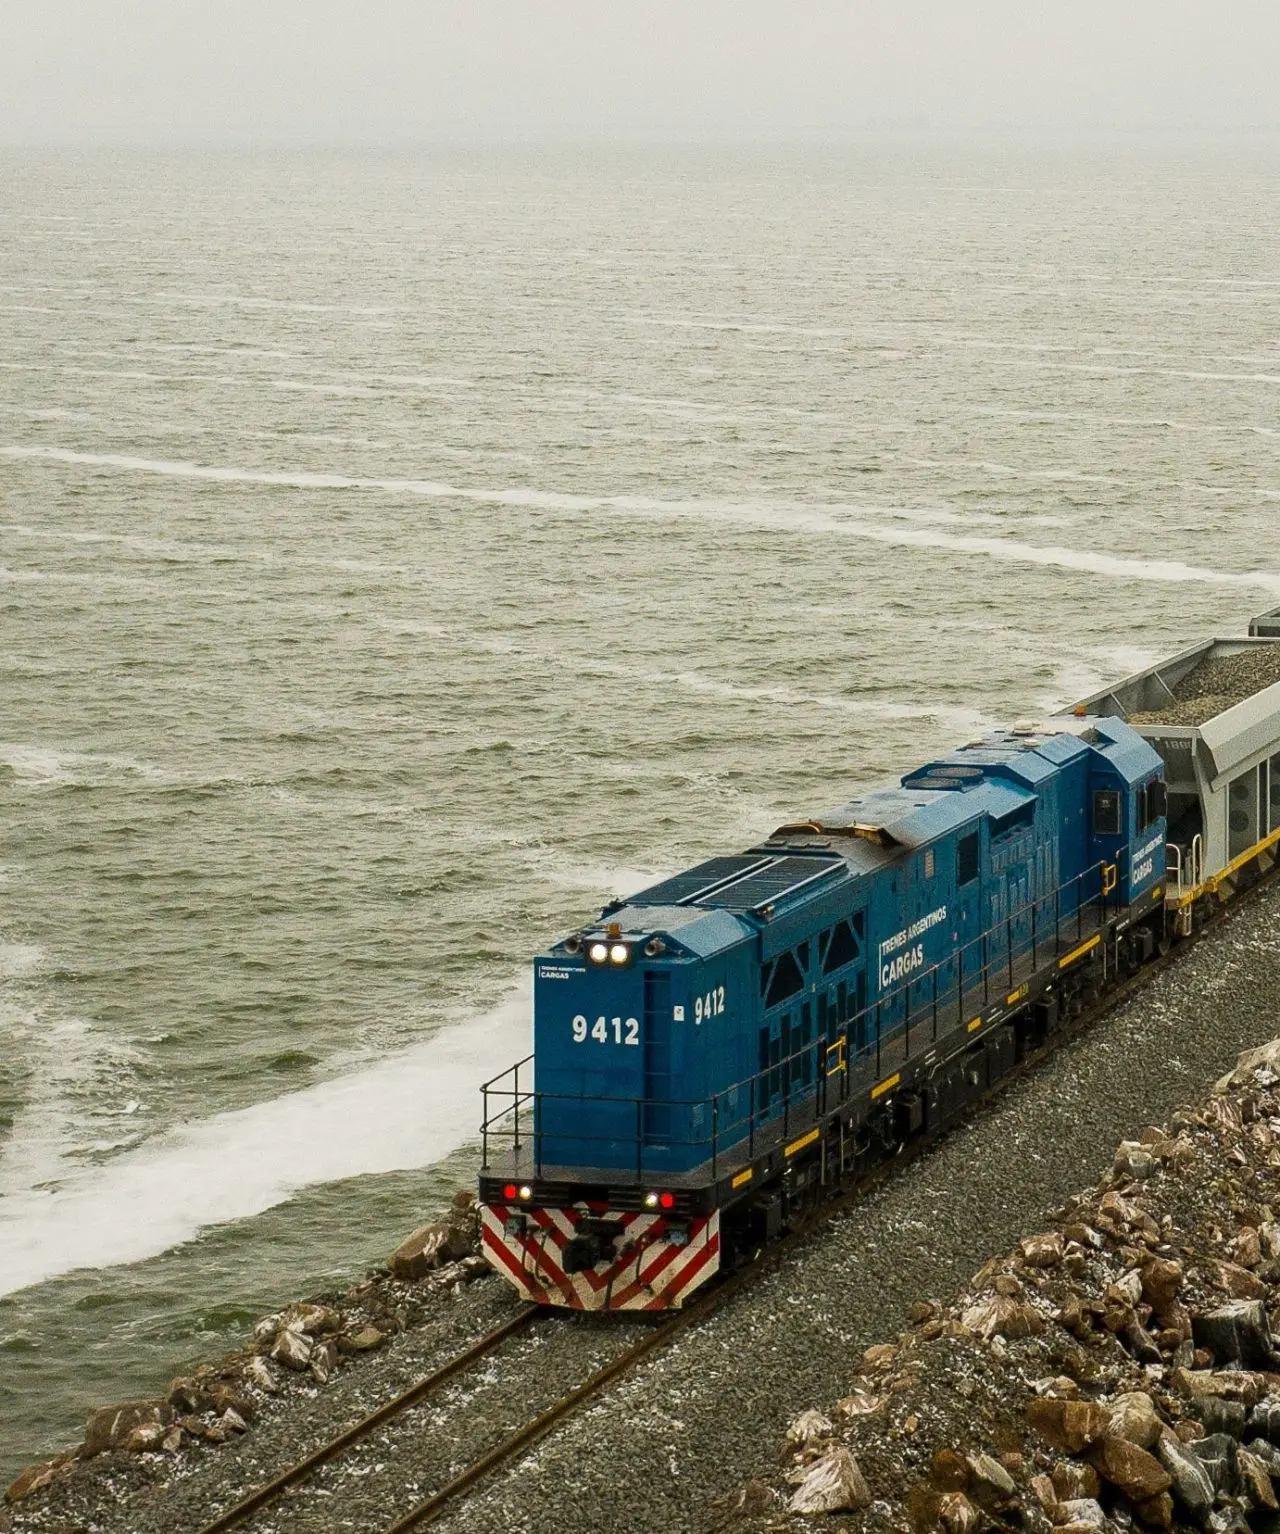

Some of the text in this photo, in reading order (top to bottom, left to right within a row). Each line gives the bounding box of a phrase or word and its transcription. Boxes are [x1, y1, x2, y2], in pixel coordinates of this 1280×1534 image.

[882, 905, 947, 956] TRENES ARGENTINOS
[541, 971, 570, 979] CARGAS
[881, 943, 924, 988] CARGAS
[694, 985, 725, 1026] 9412
[571, 1014, 640, 1046] 9412
